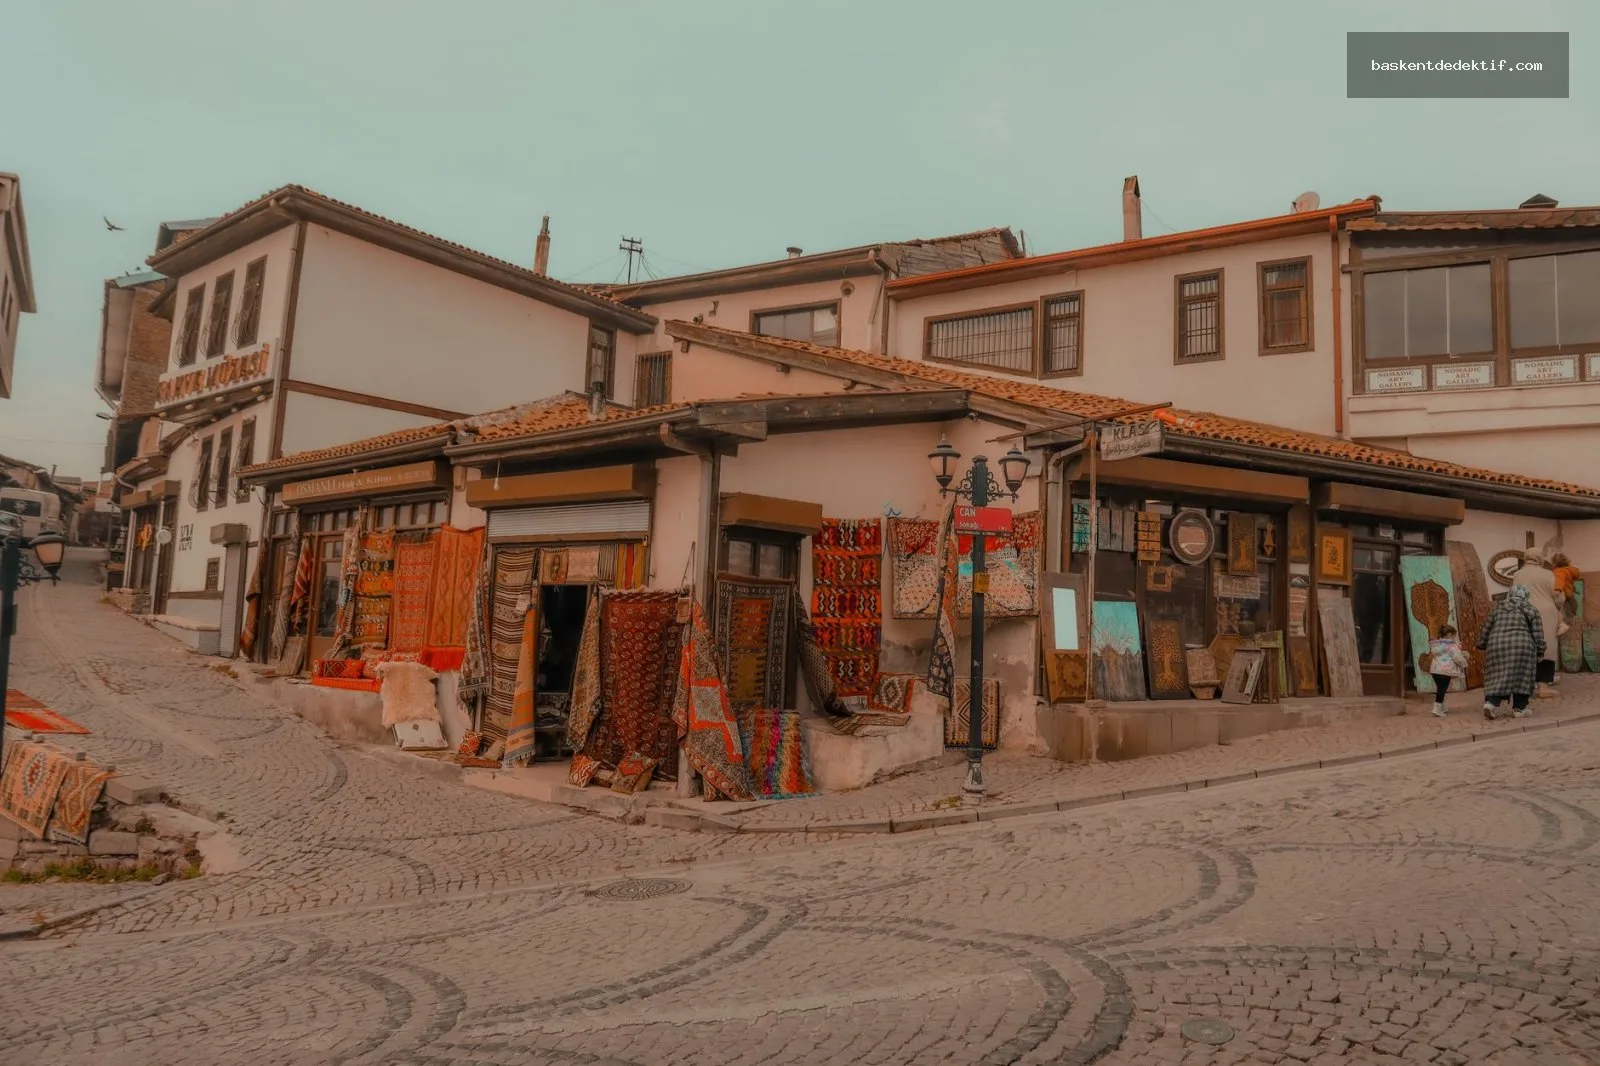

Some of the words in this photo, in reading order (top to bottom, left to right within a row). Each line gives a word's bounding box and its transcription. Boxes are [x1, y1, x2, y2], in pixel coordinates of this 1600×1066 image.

[1524, 360, 1565, 369] NOMADIC
[1377, 370, 1414, 378] NOMADIC
[1525, 372, 1563, 380] GALLERY
[1378, 381, 1414, 389] GALLERY
[1445, 377, 1480, 385] GALLERY
[1113, 423, 1146, 441] KLAS
[296, 478, 336, 497] OSMANLI
[959, 507, 976, 517] CAN
